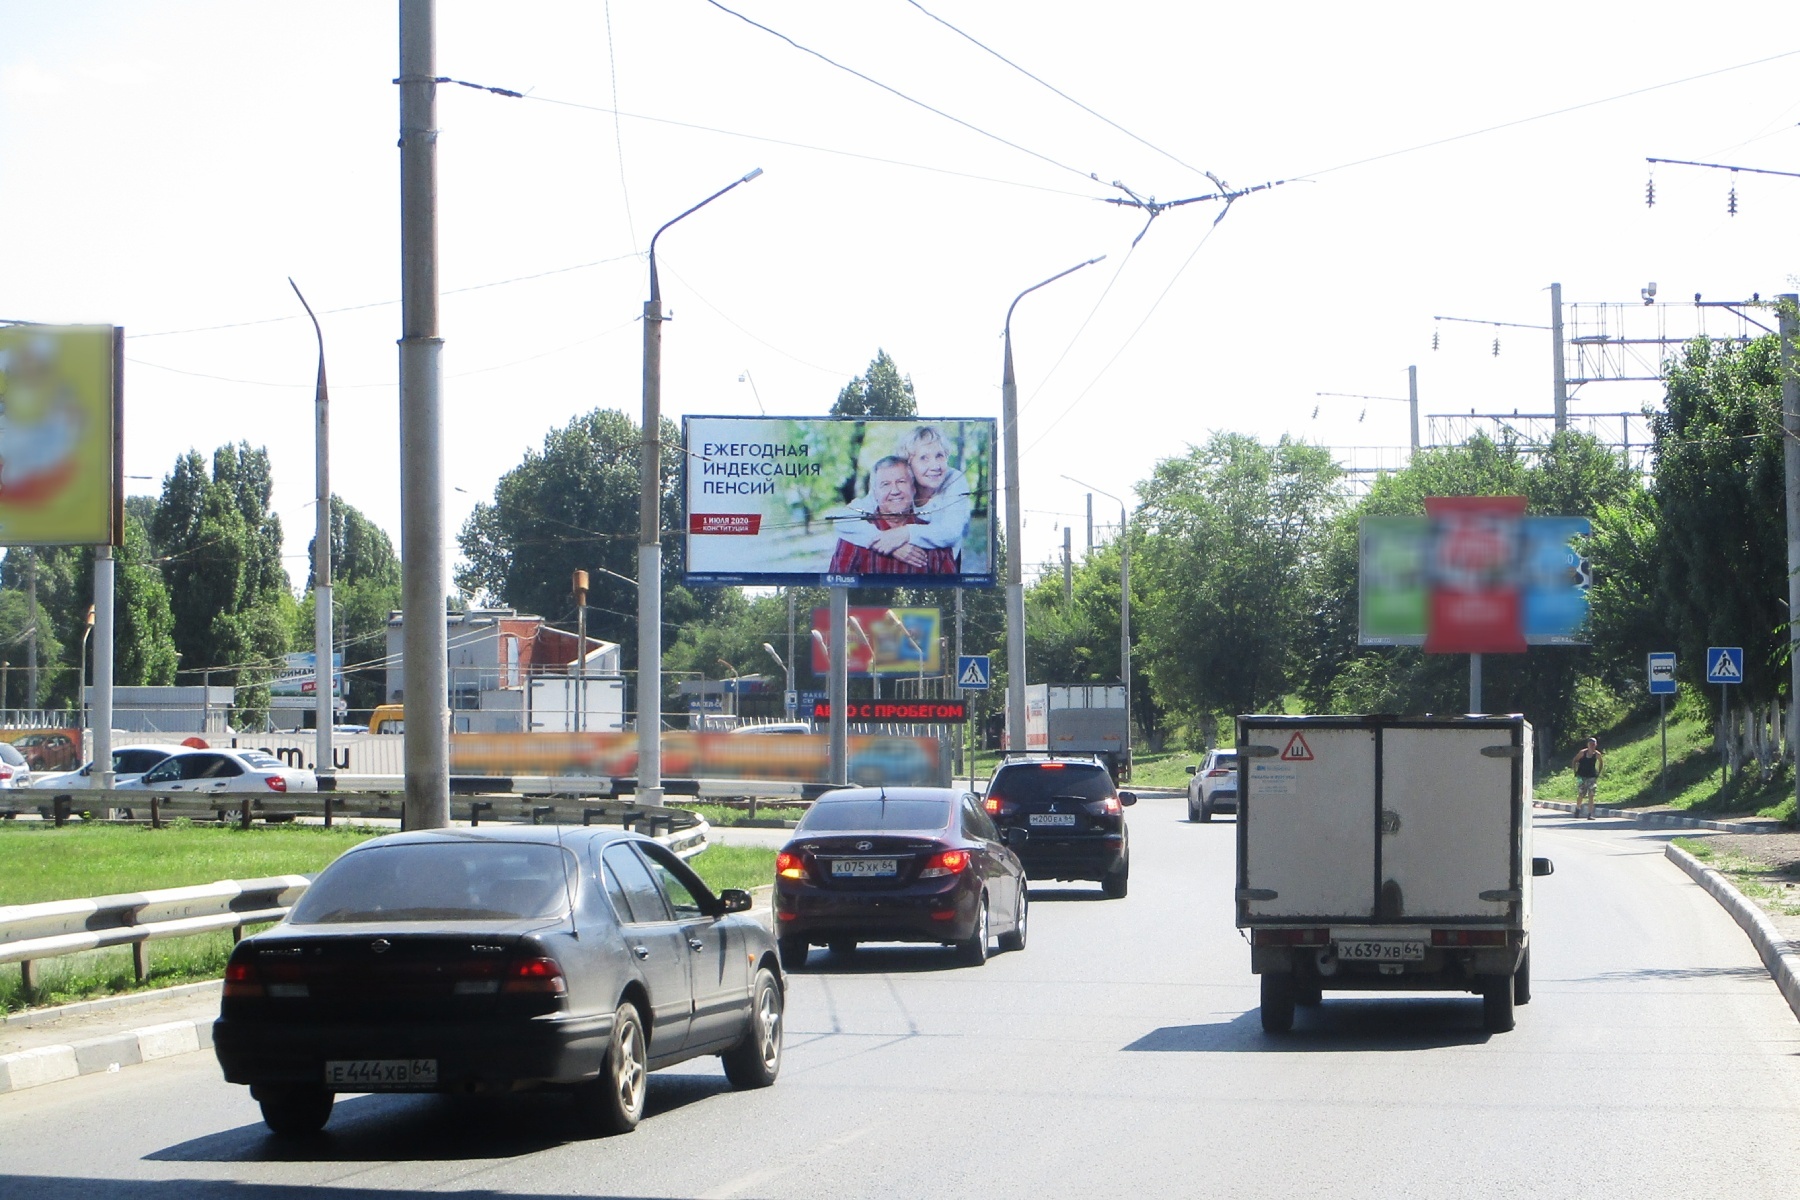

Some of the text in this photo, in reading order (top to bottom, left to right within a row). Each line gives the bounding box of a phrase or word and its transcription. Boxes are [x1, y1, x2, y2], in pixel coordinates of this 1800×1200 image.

[704, 443, 809, 459] ЕЖЕГОДНАЯ
[703, 462, 820, 478] ИНДЕКСАЦИЯ
[703, 478, 775, 495] ПЕНСИЙ
[708, 517, 730, 525] ИЮЛЯ
[730, 517, 749, 525] 2020
[835, 574, 856, 583] Russ
[814, 704, 964, 718] АВО С ПРОБЕГОМ
[1291, 746, 1304, 757] Ш
